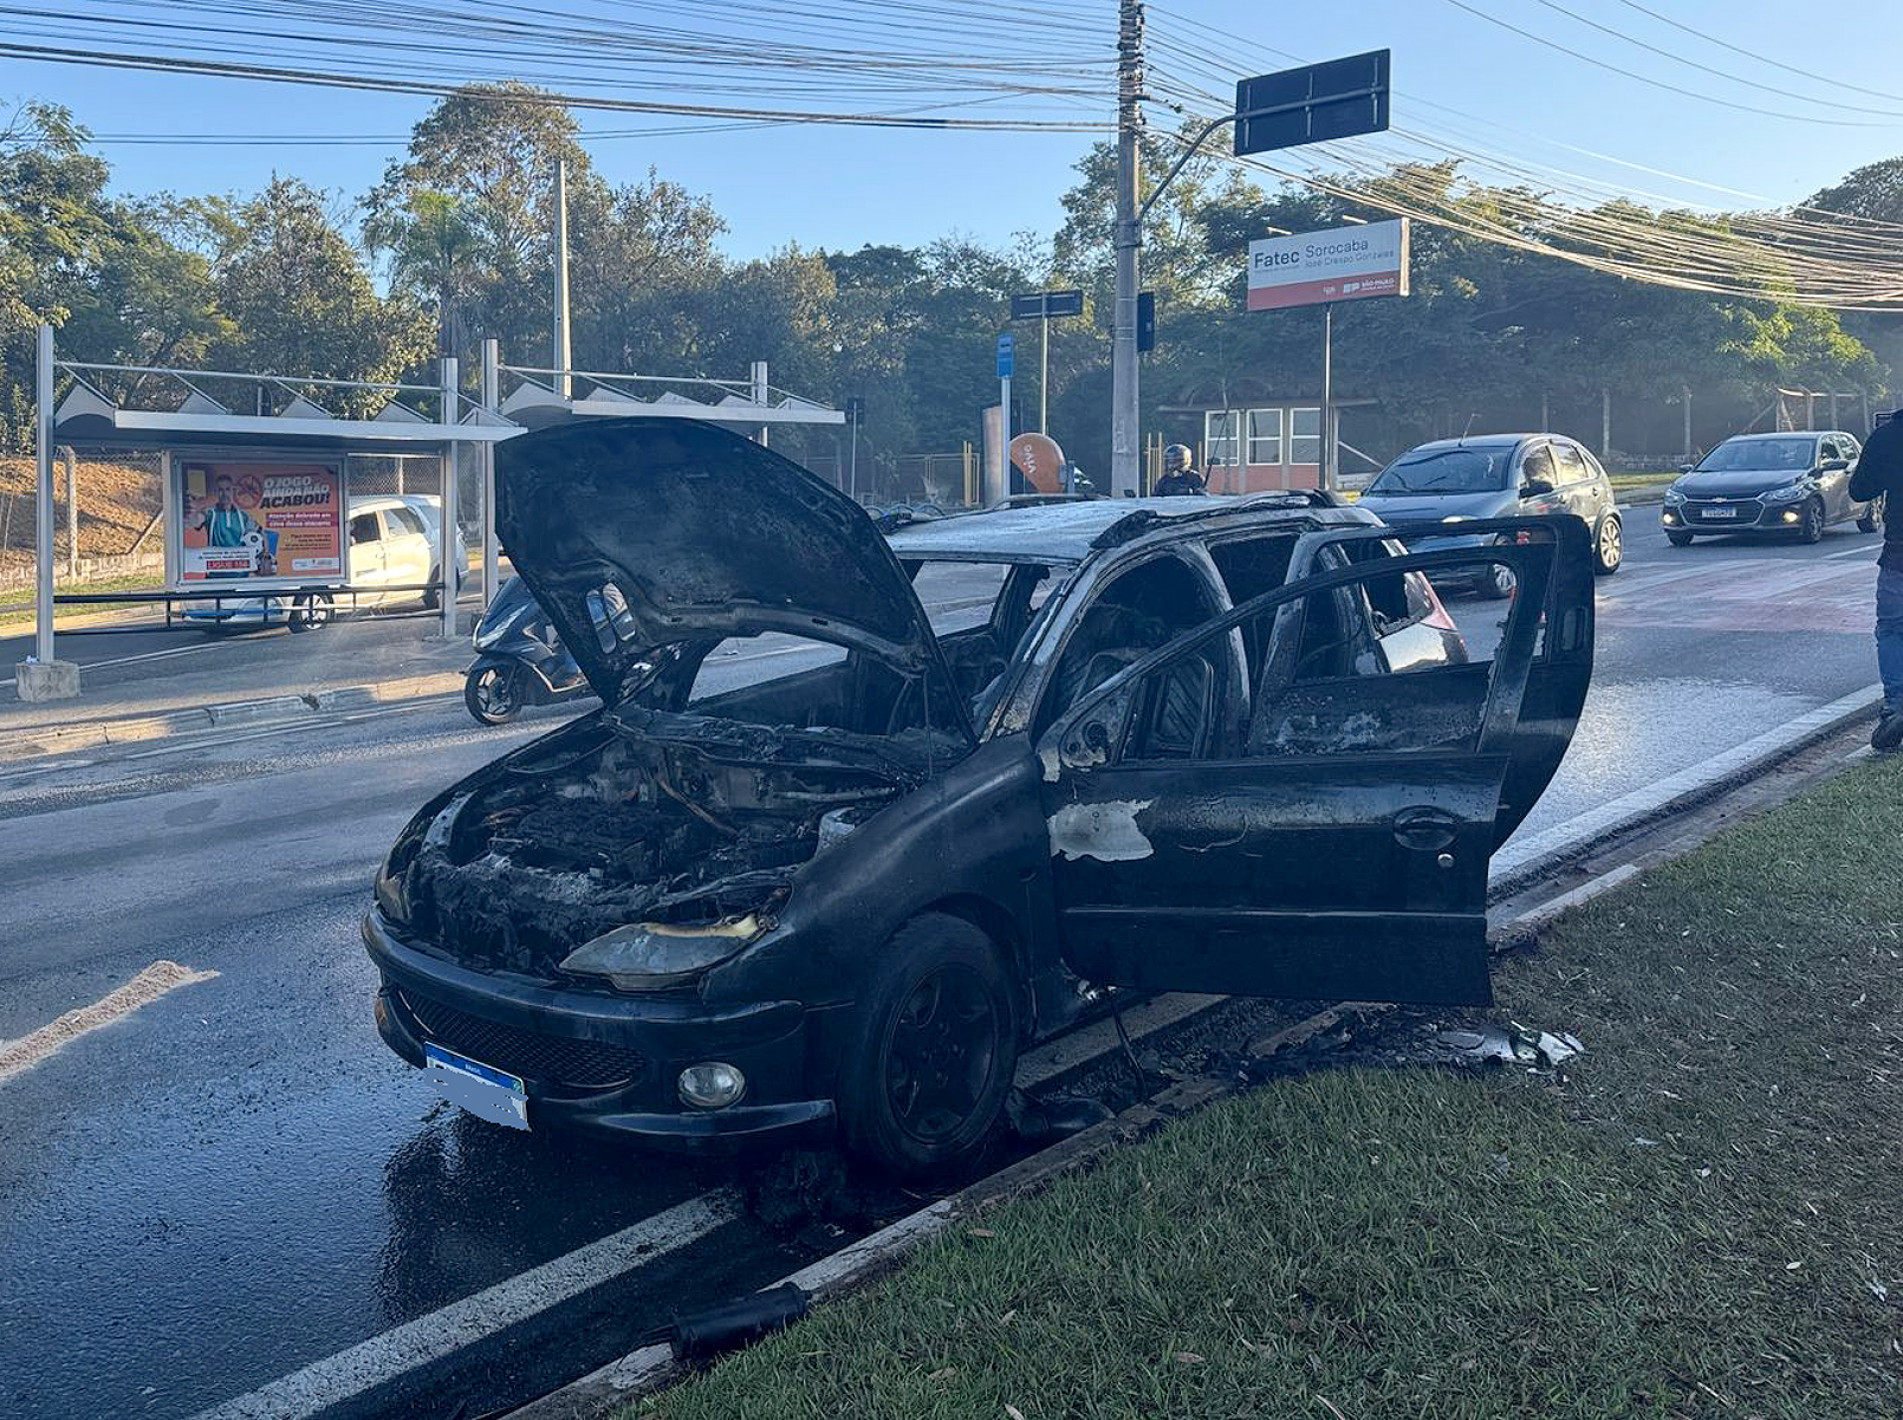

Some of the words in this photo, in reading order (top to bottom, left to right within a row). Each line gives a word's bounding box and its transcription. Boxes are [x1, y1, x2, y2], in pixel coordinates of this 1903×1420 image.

[1254, 252, 1299, 268] Fatec
[1305, 240, 1368, 258] Sorocaba
[1324, 256, 1352, 267] Crespo
[275, 476, 312, 486] JOGO
[263, 486, 302, 497] AINDA
[260, 493, 331, 509] ACABOU!
